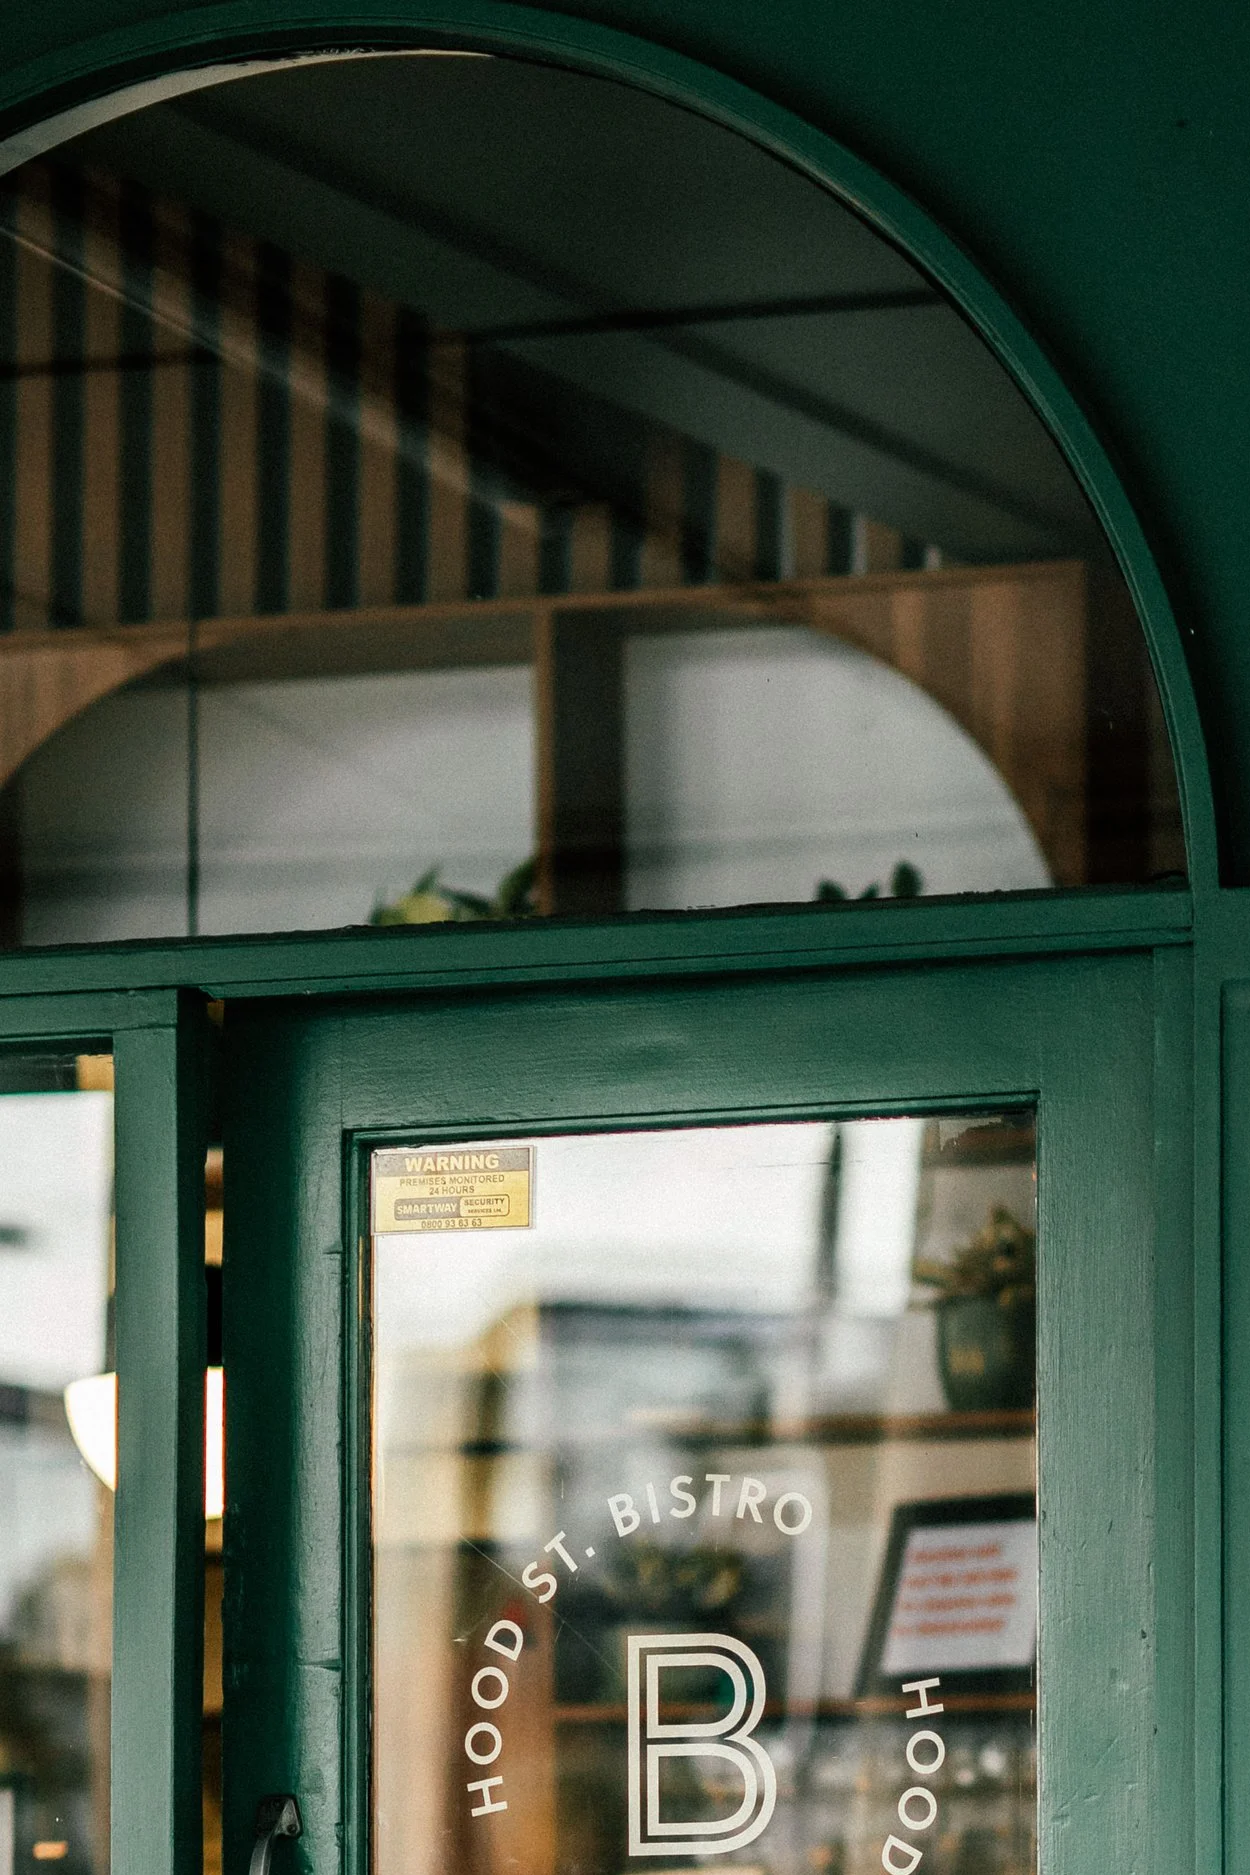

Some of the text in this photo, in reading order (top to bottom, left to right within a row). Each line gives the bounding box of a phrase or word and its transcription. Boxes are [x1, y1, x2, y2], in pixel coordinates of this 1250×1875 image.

[405, 1153, 499, 1172] WARNING
[400, 1174, 505, 1186] PREMISES MONITORED
[429, 1185, 475, 1195] 24 HOURS
[464, 1198, 505, 1206] SECURITY
[396, 1203, 458, 1215] SMARTWAY
[421, 1220, 443, 1229] 0800
[445, 1219, 456, 1228] 93
[464, 1473, 812, 1817] HOOD ST. BISTRO
[627, 1633, 777, 1857] B
